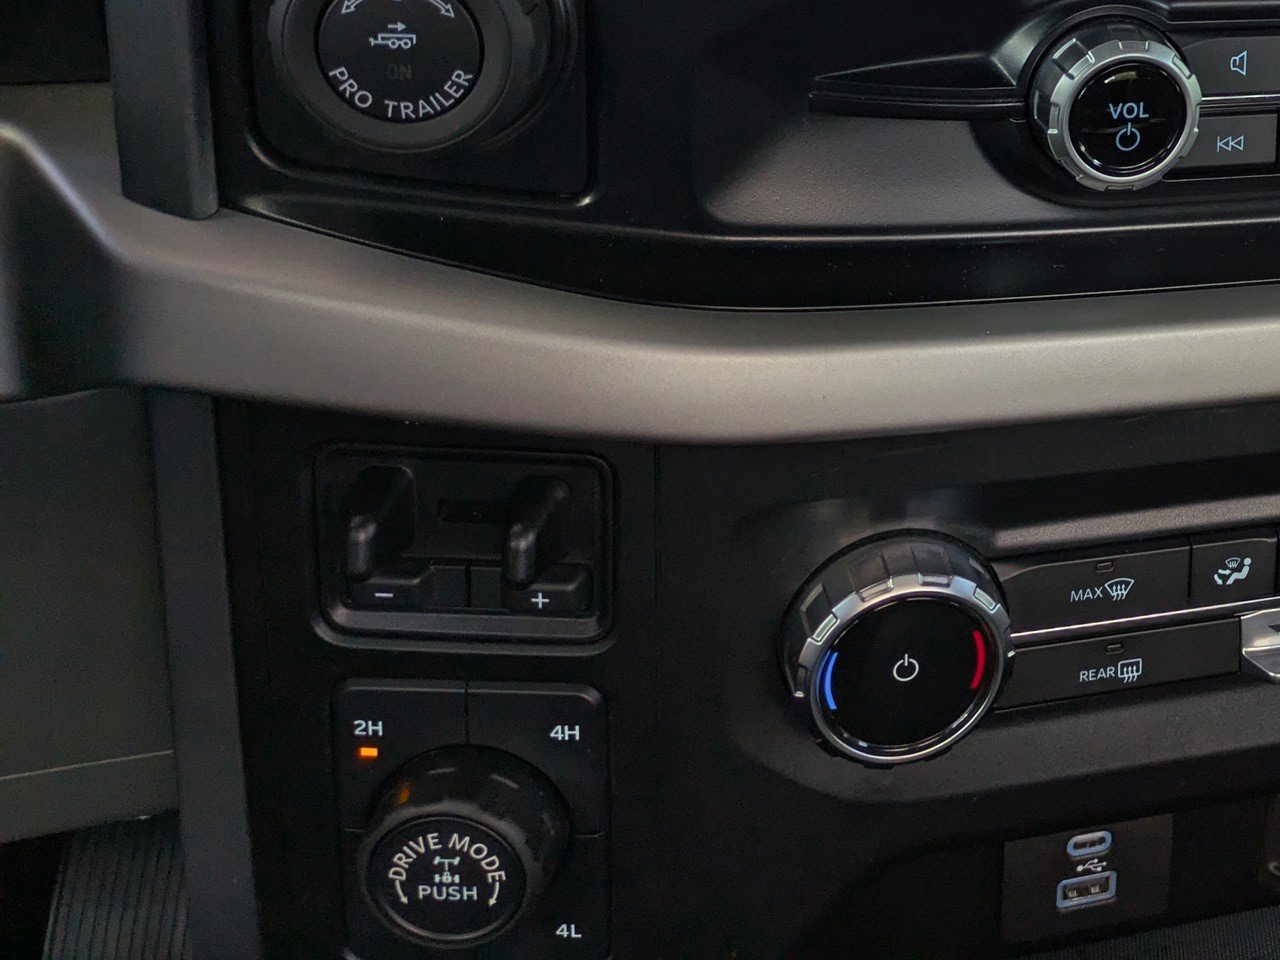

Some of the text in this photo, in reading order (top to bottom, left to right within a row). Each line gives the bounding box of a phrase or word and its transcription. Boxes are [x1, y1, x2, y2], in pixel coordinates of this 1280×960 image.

[329, 66, 474, 120] PRO TRAILER
[1108, 102, 1150, 121] VOL
[1070, 587, 1104, 603] MAX
[1079, 665, 1115, 682] REAR
[353, 720, 384, 737] 2H
[549, 725, 580, 741] 4H
[388, 832, 506, 883] DRIVE MODE
[418, 885, 478, 901] PUSH
[555, 924, 582, 939] 4L
